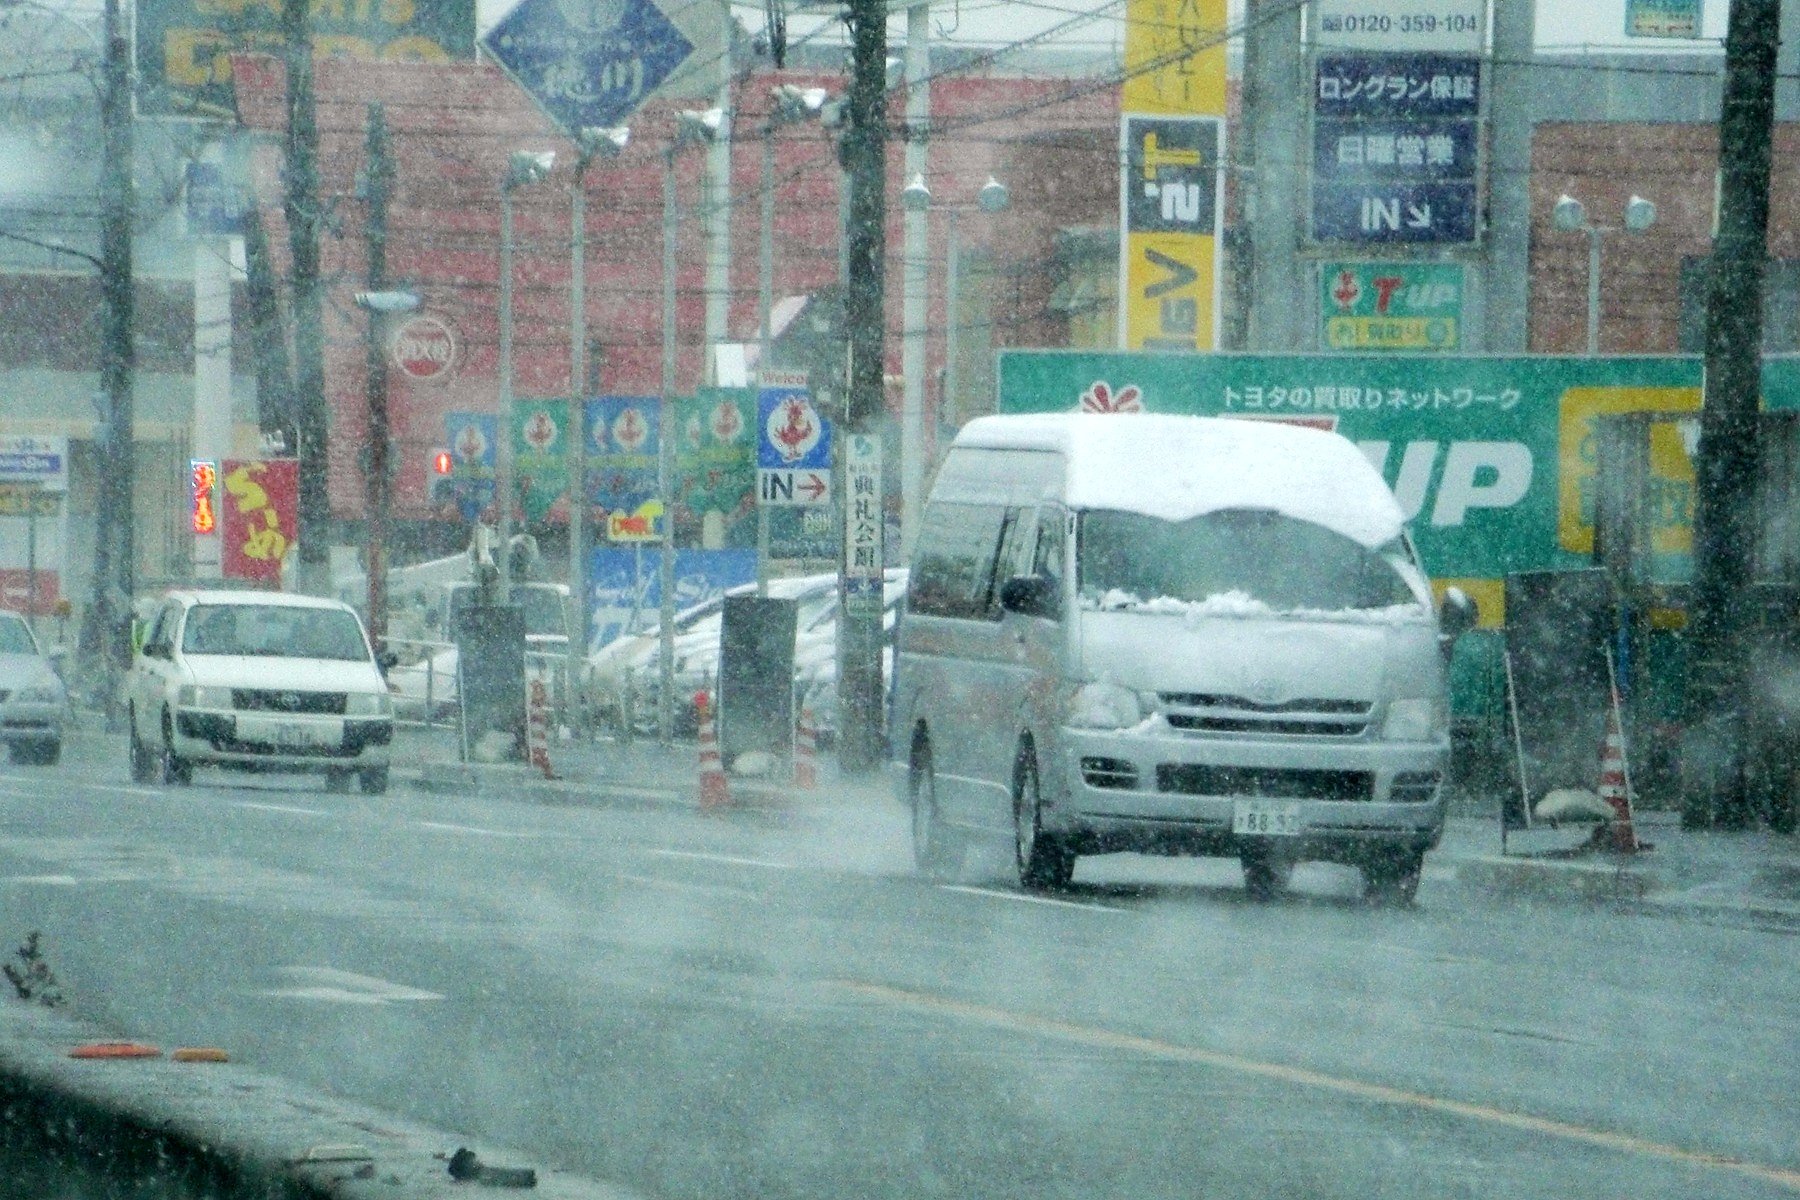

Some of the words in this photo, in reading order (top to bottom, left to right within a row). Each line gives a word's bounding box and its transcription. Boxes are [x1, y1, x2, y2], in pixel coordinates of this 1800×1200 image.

[1344, 14, 1477, 33] 0120-359-104
[1319, 75, 1475, 100] ロングラン保証
[1337, 134, 1454, 165] 日曜営業
[1361, 197, 1400, 231] IN
[1223, 385, 1523, 410] トヨタの買取りネットワーク
[762, 473, 794, 501] IN
